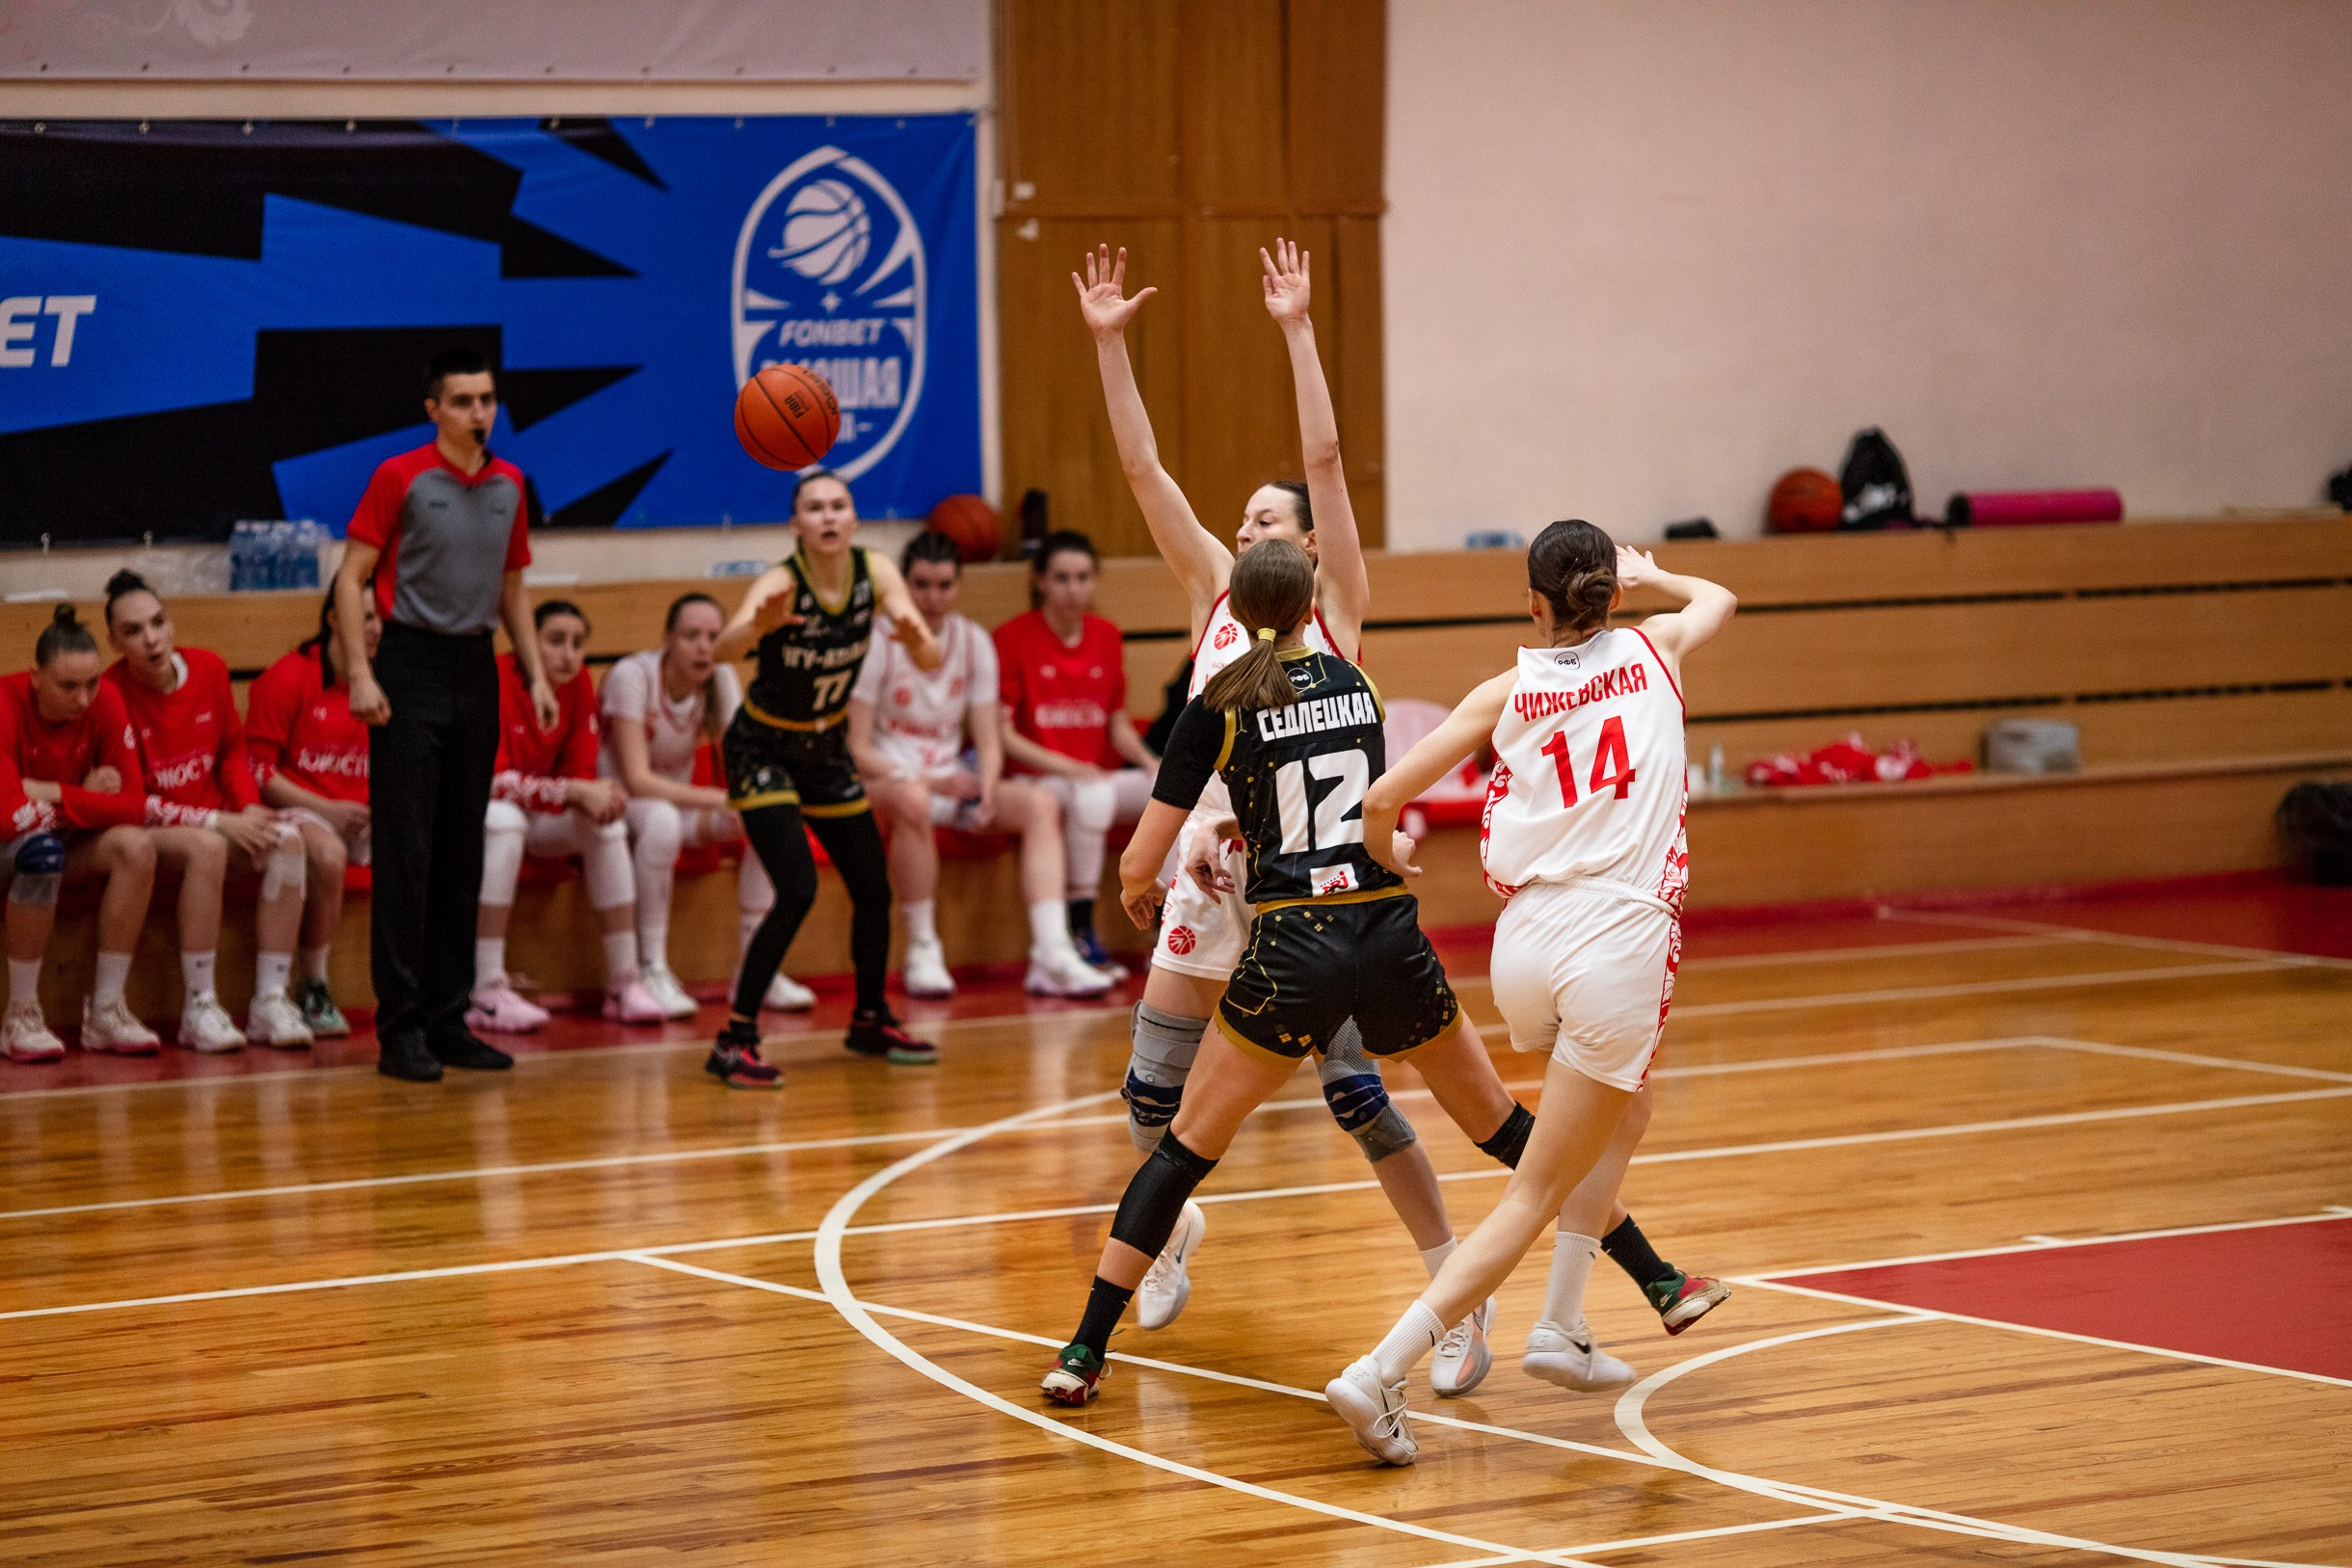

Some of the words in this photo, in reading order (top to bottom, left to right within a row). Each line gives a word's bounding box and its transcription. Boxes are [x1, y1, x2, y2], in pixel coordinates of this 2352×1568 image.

[813, 669, 853, 712] 77
[1256, 691, 1377, 742] СЕДЛЕЦКАЯ
[1514, 663, 1648, 723] ЧИЖЕВСКАЯ
[1540, 715, 1637, 810] 14
[1275, 749, 1370, 855] 12
